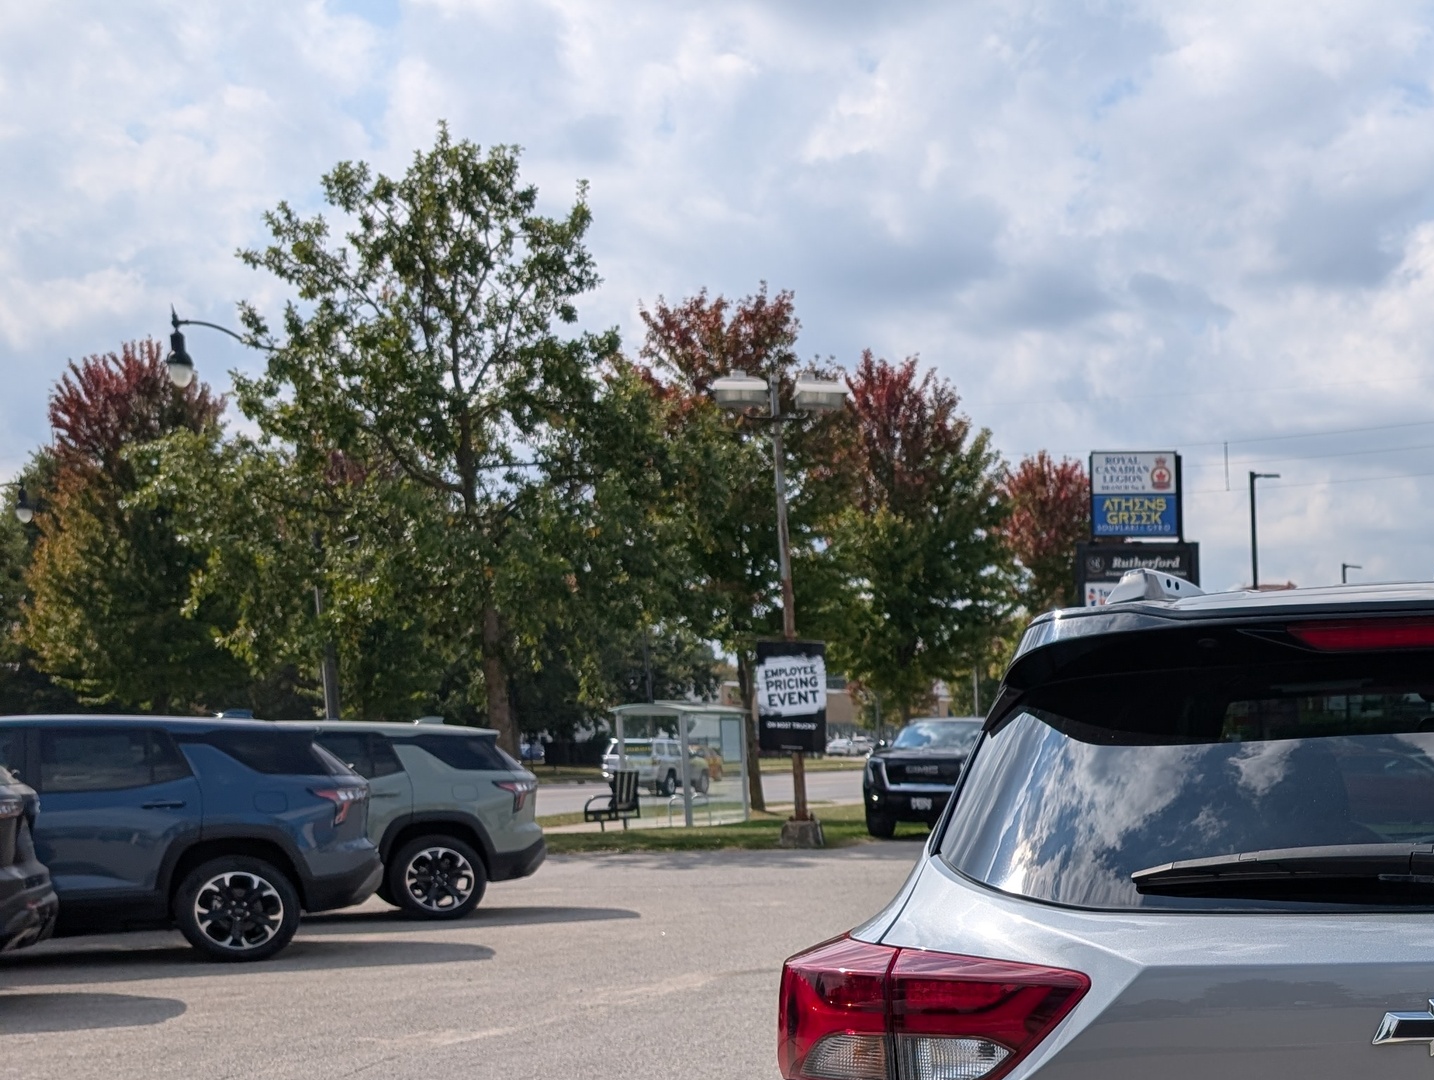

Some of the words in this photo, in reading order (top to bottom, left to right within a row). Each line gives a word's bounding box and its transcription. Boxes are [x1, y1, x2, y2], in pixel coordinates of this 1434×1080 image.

[1105, 456, 1140, 465] ROYAL
[1095, 465, 1150, 474] CANADIAN
[1102, 474, 1143, 483] LEGION
[1112, 556, 1181, 570] Rutherford
[764, 665, 818, 680] EMPLOYEE
[765, 676, 819, 692] PRICING
[767, 690, 820, 708] EVENT
